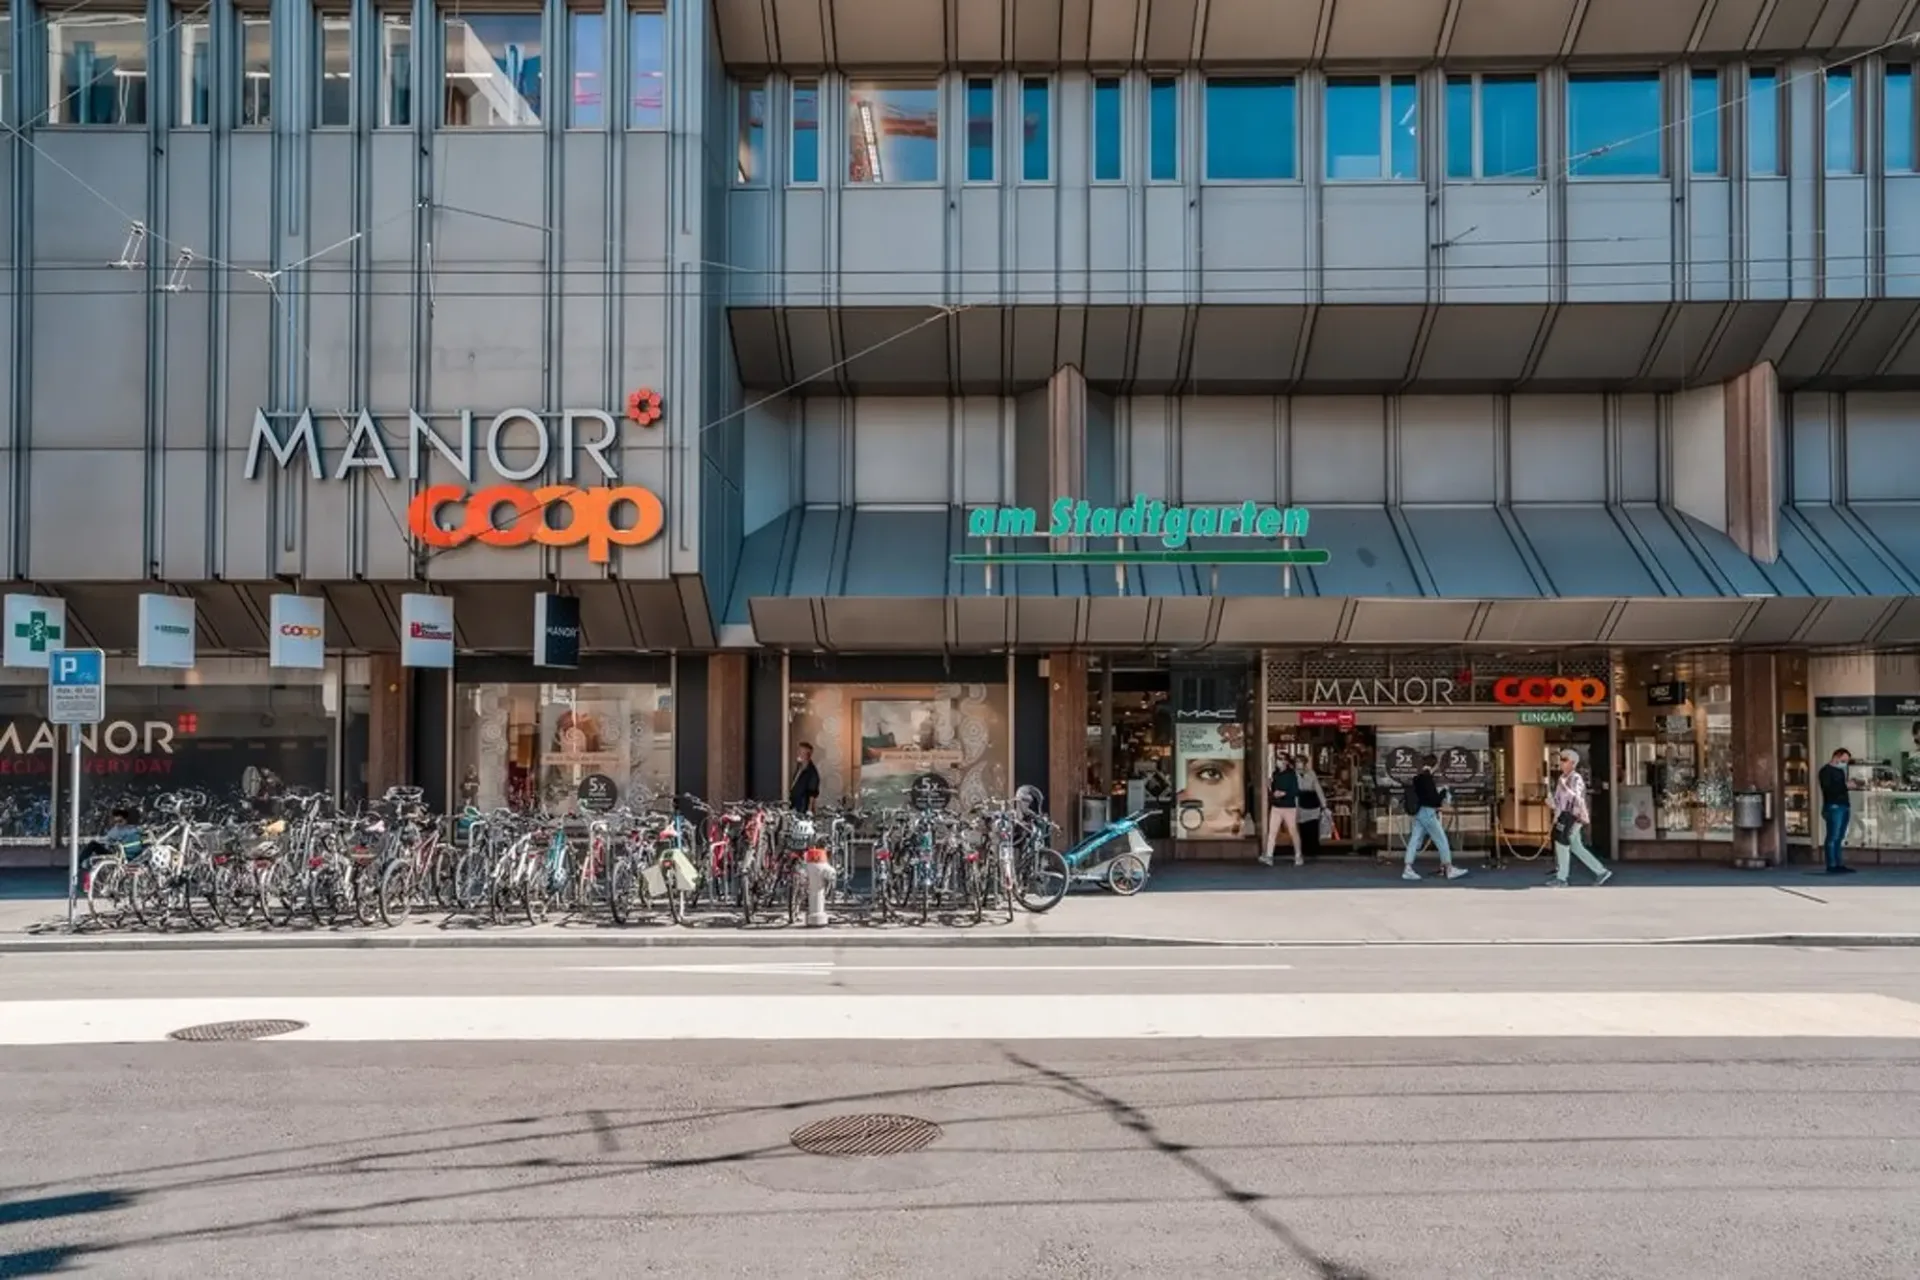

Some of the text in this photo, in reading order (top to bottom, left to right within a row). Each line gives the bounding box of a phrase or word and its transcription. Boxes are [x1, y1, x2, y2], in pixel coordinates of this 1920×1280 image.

[243, 406, 618, 480] MANOR
[408, 484, 664, 563] coop
[968, 492, 1311, 548] am Stadtgarten
[60, 657, 77, 682] P
[1312, 676, 1454, 705] MANOR
[1494, 676, 1606, 712] coop
[1521, 712, 1574, 723] EINGANG
[0, 721, 174, 754] MANOR
[83, 758, 174, 775] VERYDAY
